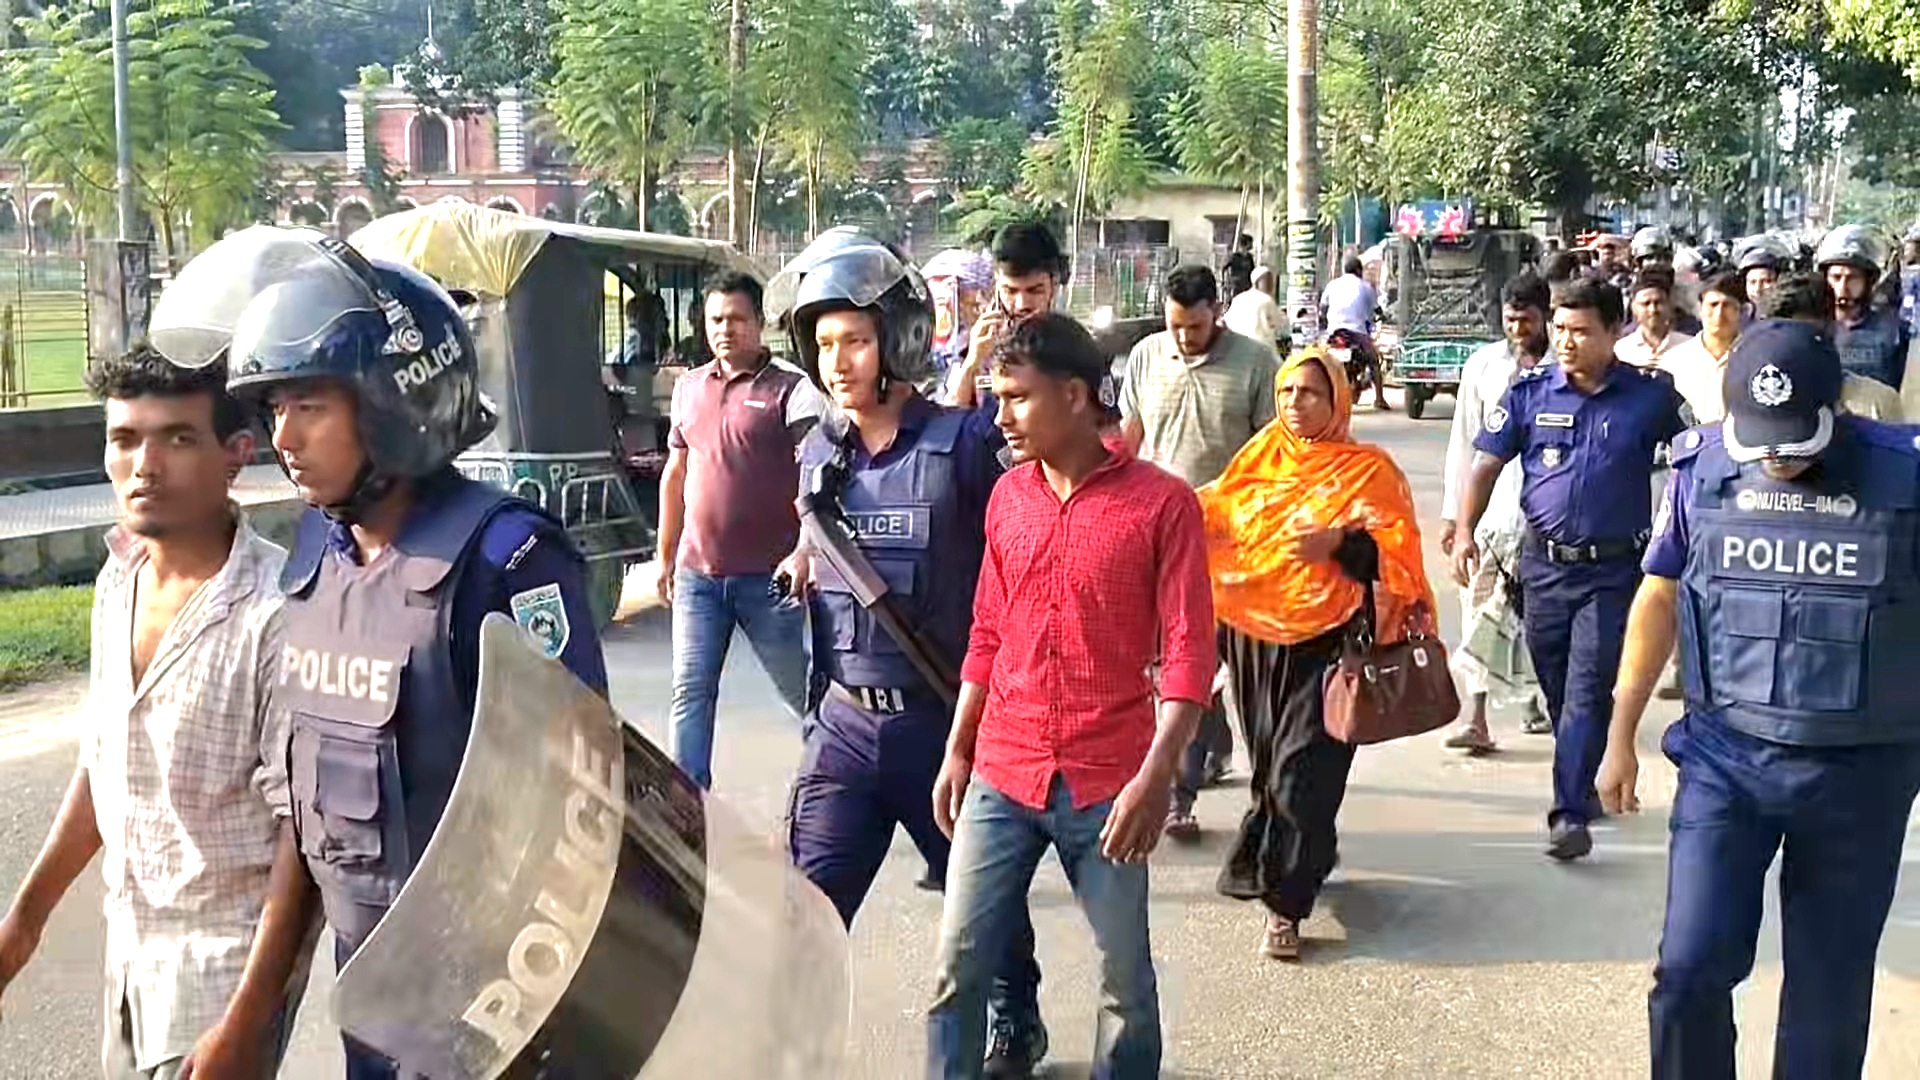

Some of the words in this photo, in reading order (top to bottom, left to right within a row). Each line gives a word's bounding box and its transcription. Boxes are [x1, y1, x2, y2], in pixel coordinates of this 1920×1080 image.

[393, 322, 462, 395] POLICE
[855, 515, 902, 534] LICE
[1722, 535, 1859, 577] POLICE
[279, 643, 393, 703] POLICE
[462, 734, 625, 1050] POLICE
